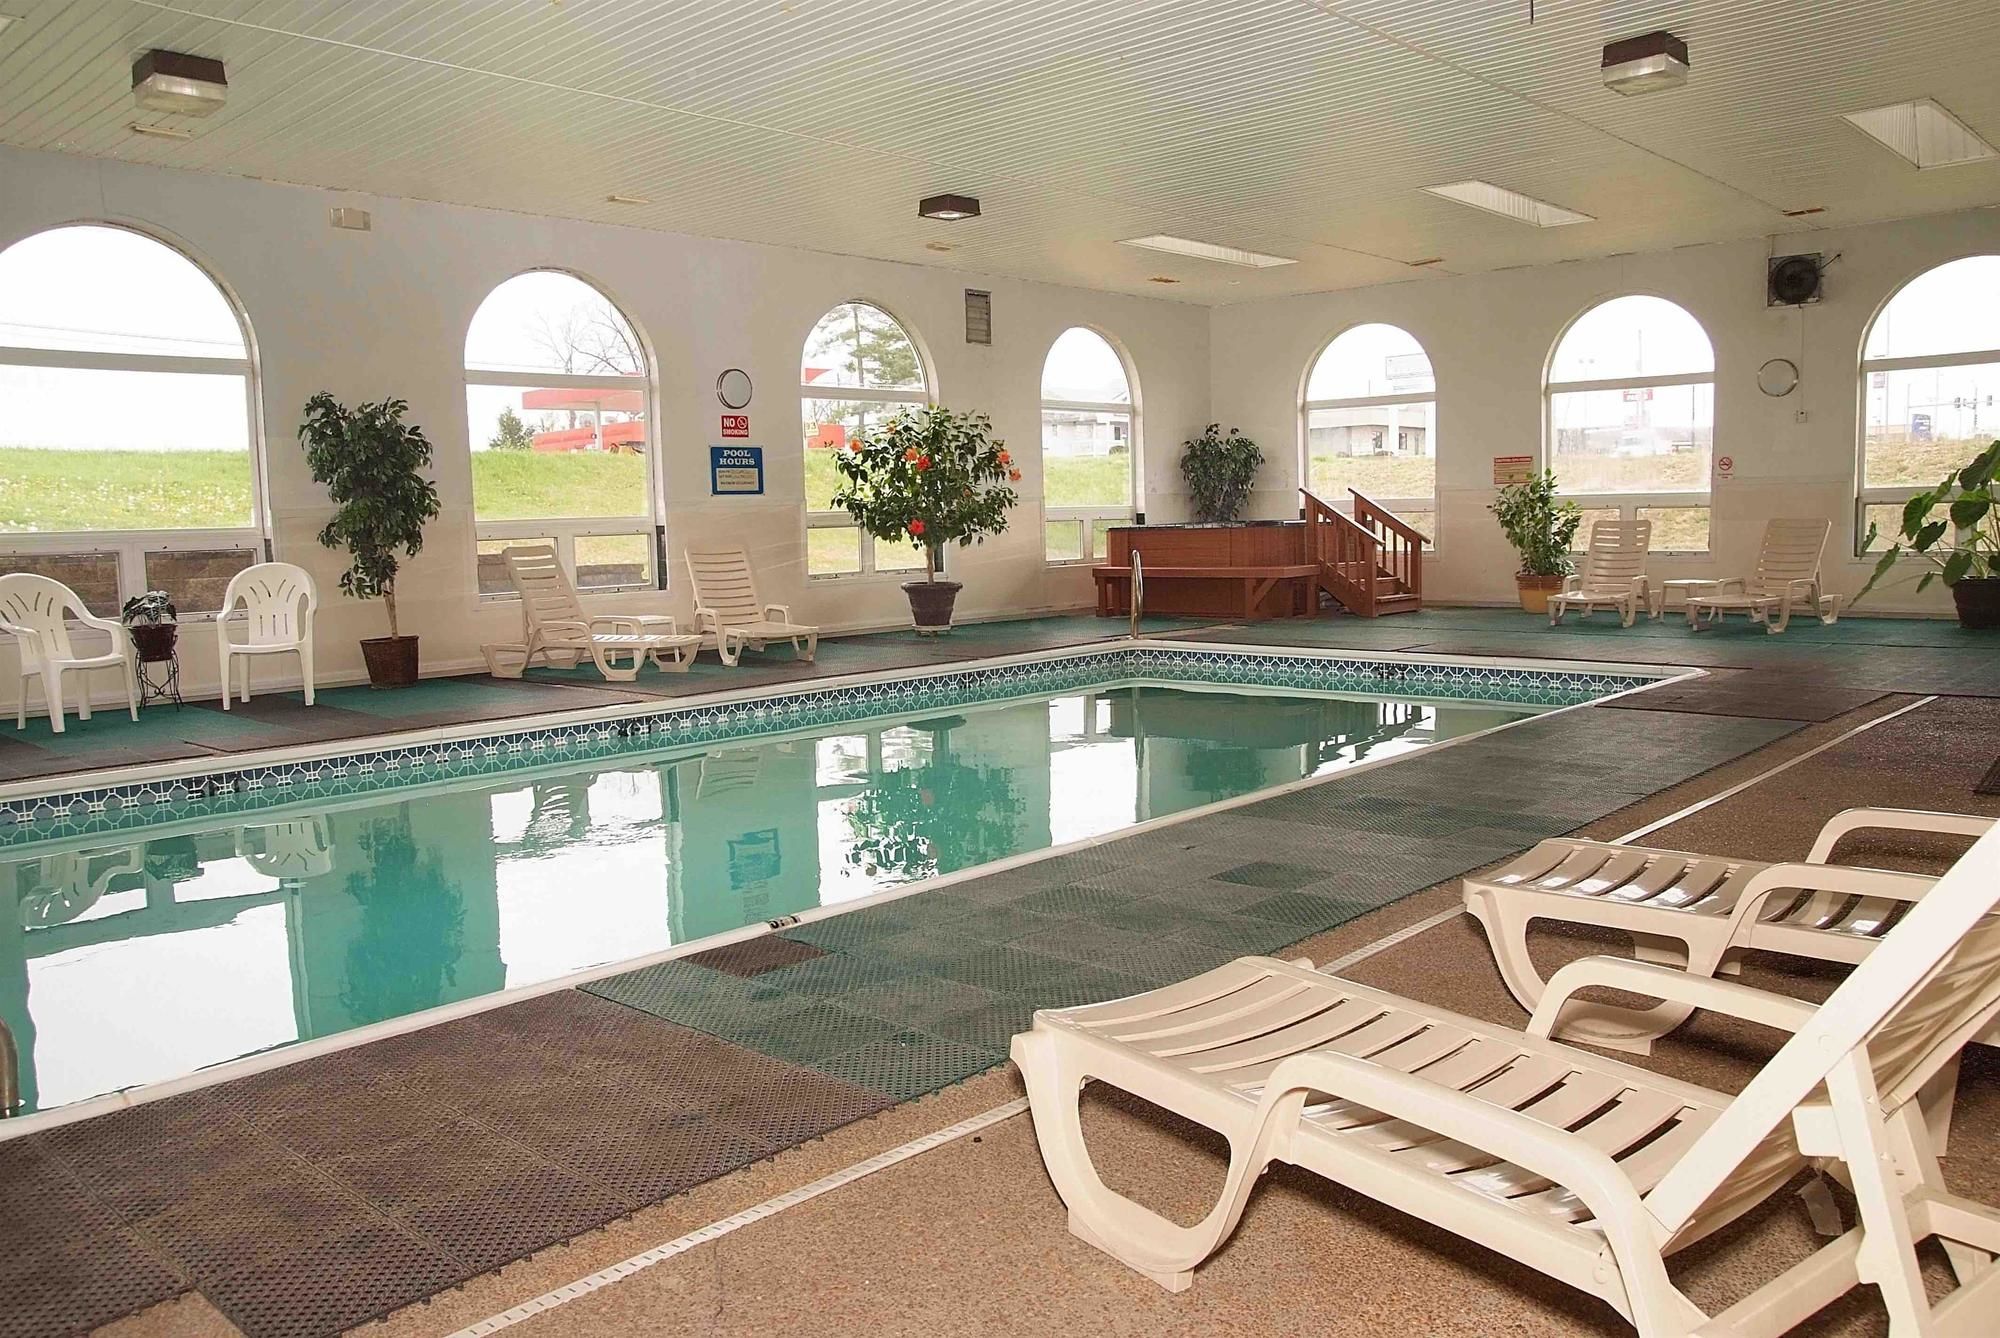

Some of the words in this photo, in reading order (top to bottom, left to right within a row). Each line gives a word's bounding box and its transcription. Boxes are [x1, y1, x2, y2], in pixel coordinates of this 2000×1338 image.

[723, 417, 735, 427] NO
[723, 449, 751, 457] POOL
[719, 457, 755, 465] HOURS
